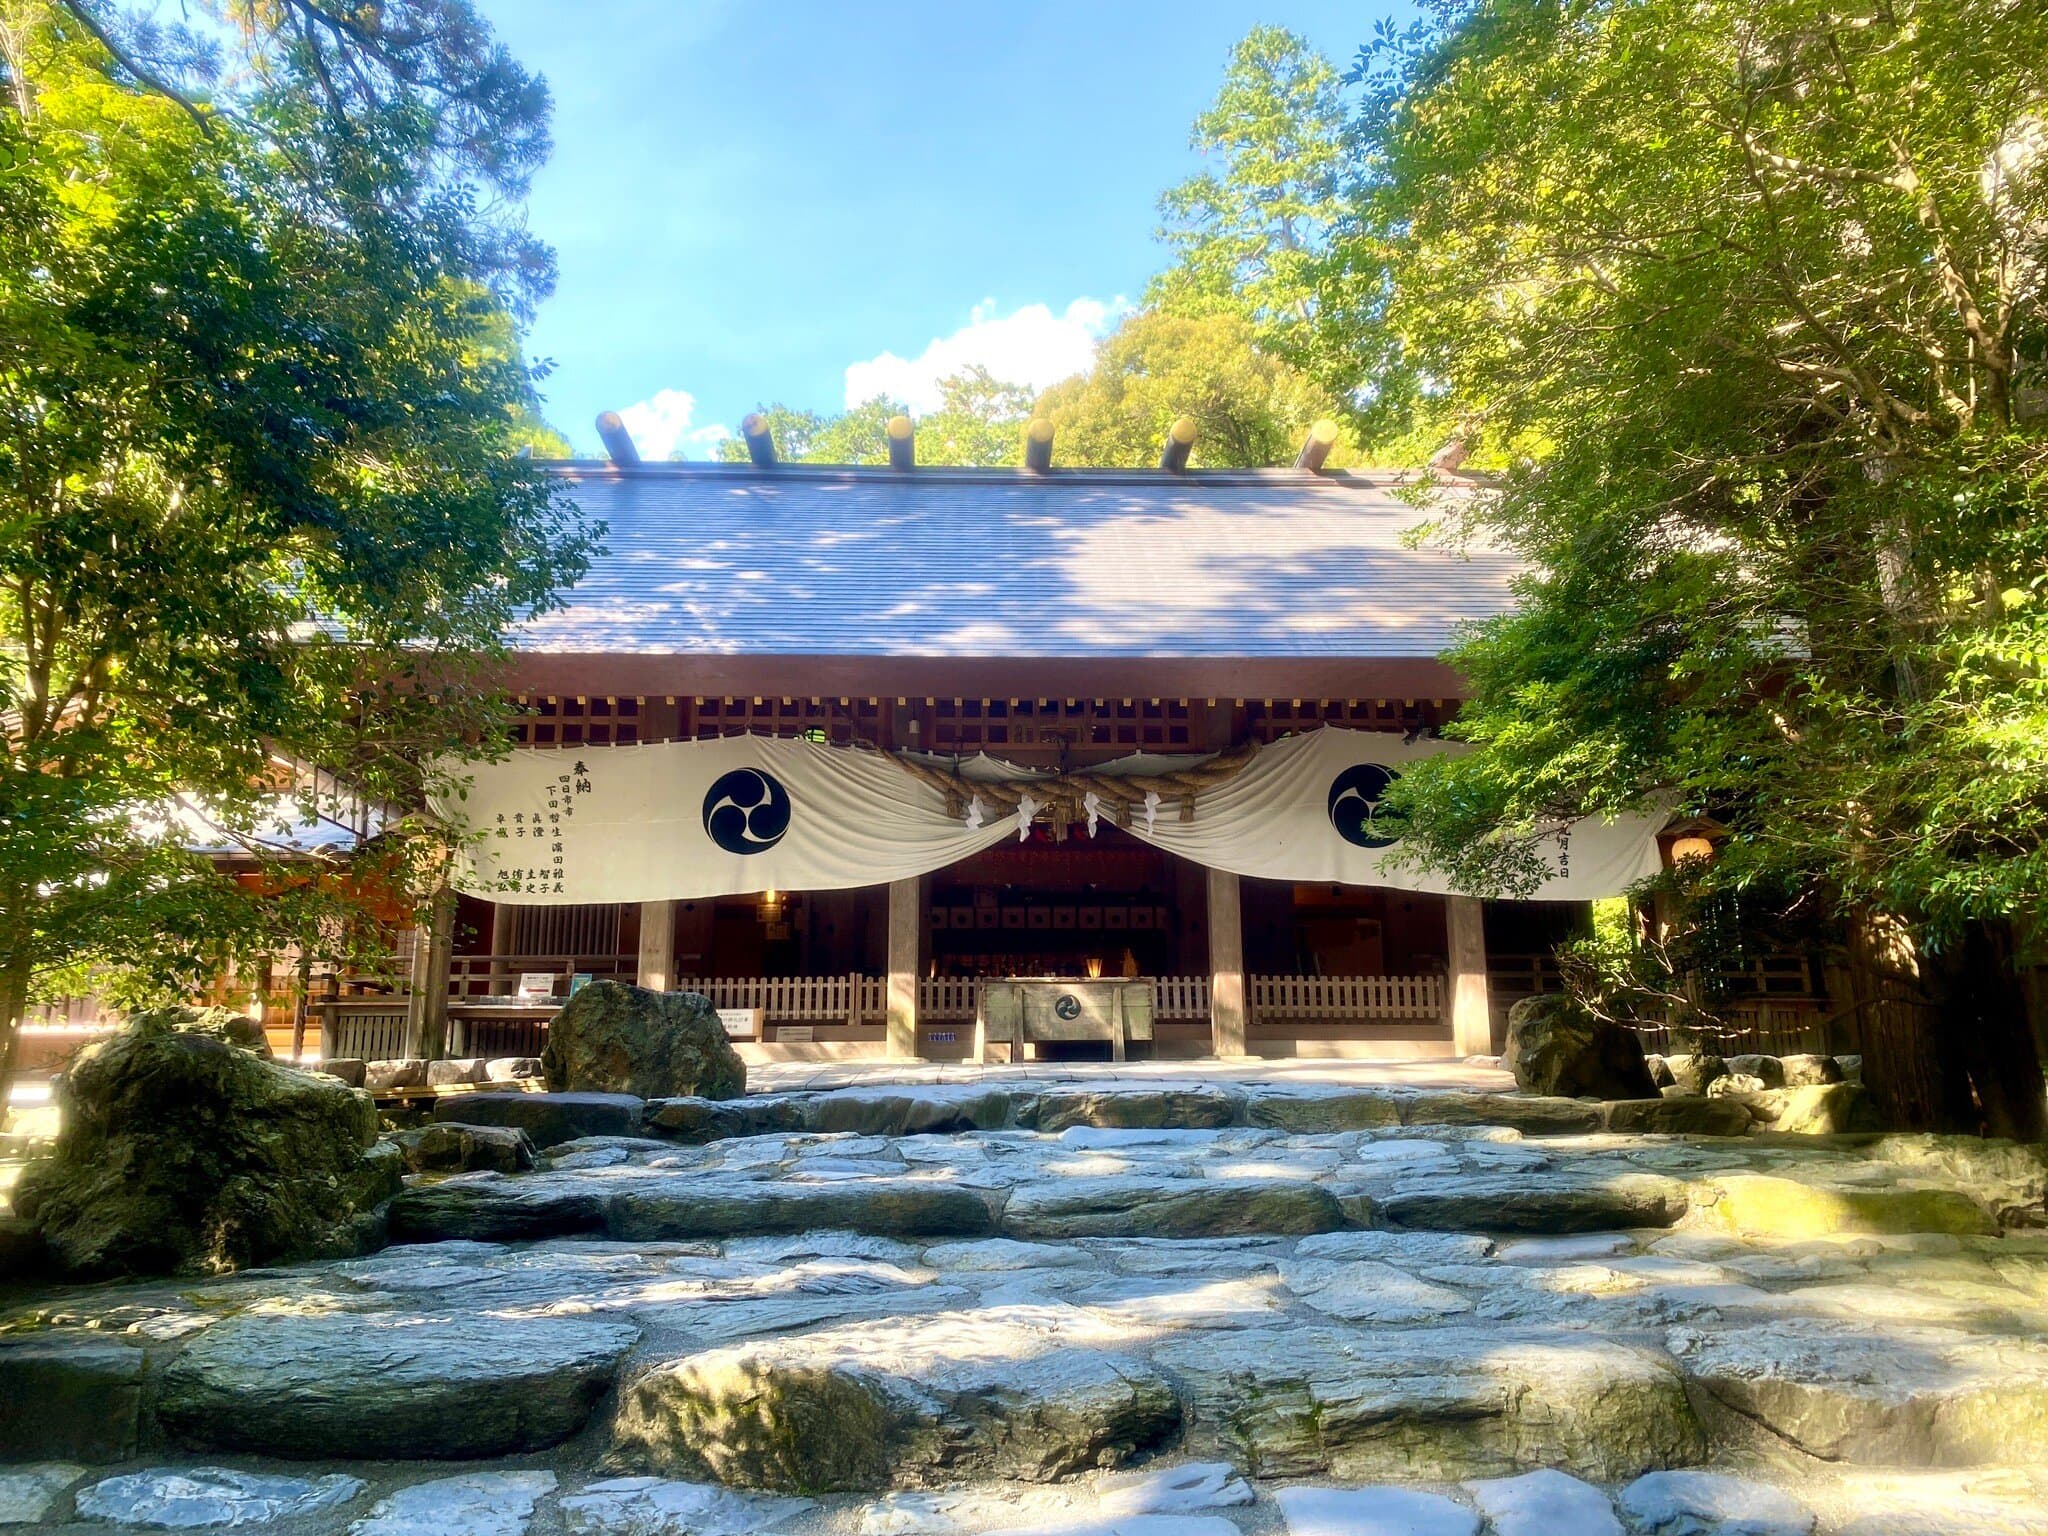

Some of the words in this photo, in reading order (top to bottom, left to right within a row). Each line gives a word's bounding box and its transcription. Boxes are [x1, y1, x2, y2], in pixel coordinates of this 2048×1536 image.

[573, 760, 592, 794] 奉納
[558, 775, 574, 817] 四日市市
[513, 812, 526, 837] 貴子
[539, 868, 551, 894] 智子
